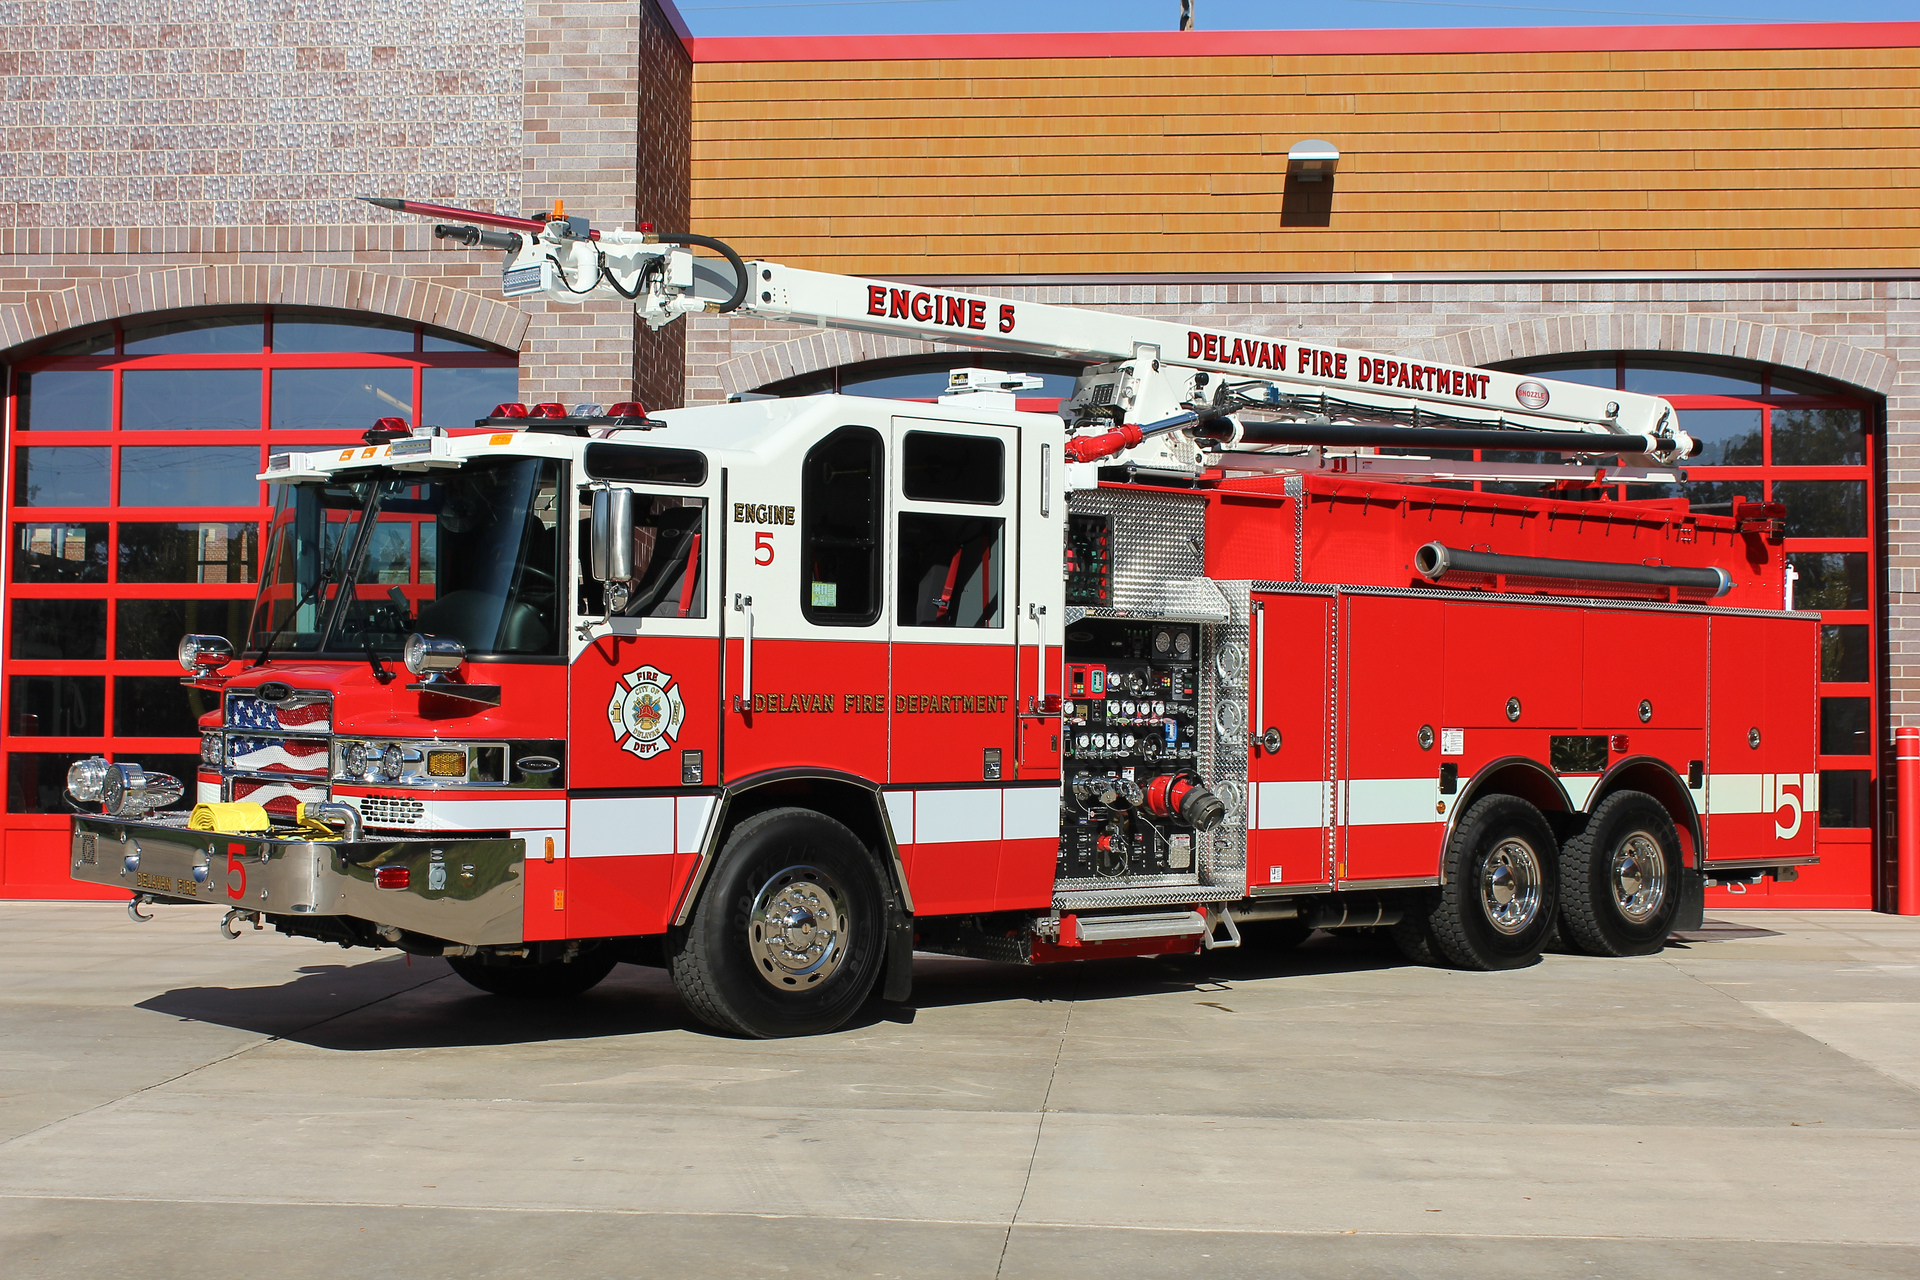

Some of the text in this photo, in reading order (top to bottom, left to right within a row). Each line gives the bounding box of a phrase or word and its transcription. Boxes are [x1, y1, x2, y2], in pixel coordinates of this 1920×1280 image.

[867, 285, 1015, 333] ENGINE 5
[1187, 331, 1490, 400] DELAVAN FIRE DEPARTMENT
[1518, 390, 1545, 399] SNOZZLE
[734, 502, 795, 526] ENGINE
[754, 531, 775, 566] 5
[636, 671, 659, 681] FIRE
[635, 686, 660, 695] CITY OF
[753, 693, 1009, 714] DELAVAN FIRE DEPARTMENT
[632, 728, 660, 738] DELAVAN
[633, 742, 659, 753] DEPT.
[1774, 773, 1802, 840] 5
[226, 842, 247, 900] 5
[136, 872, 198, 896] DELAVAN FIRE
